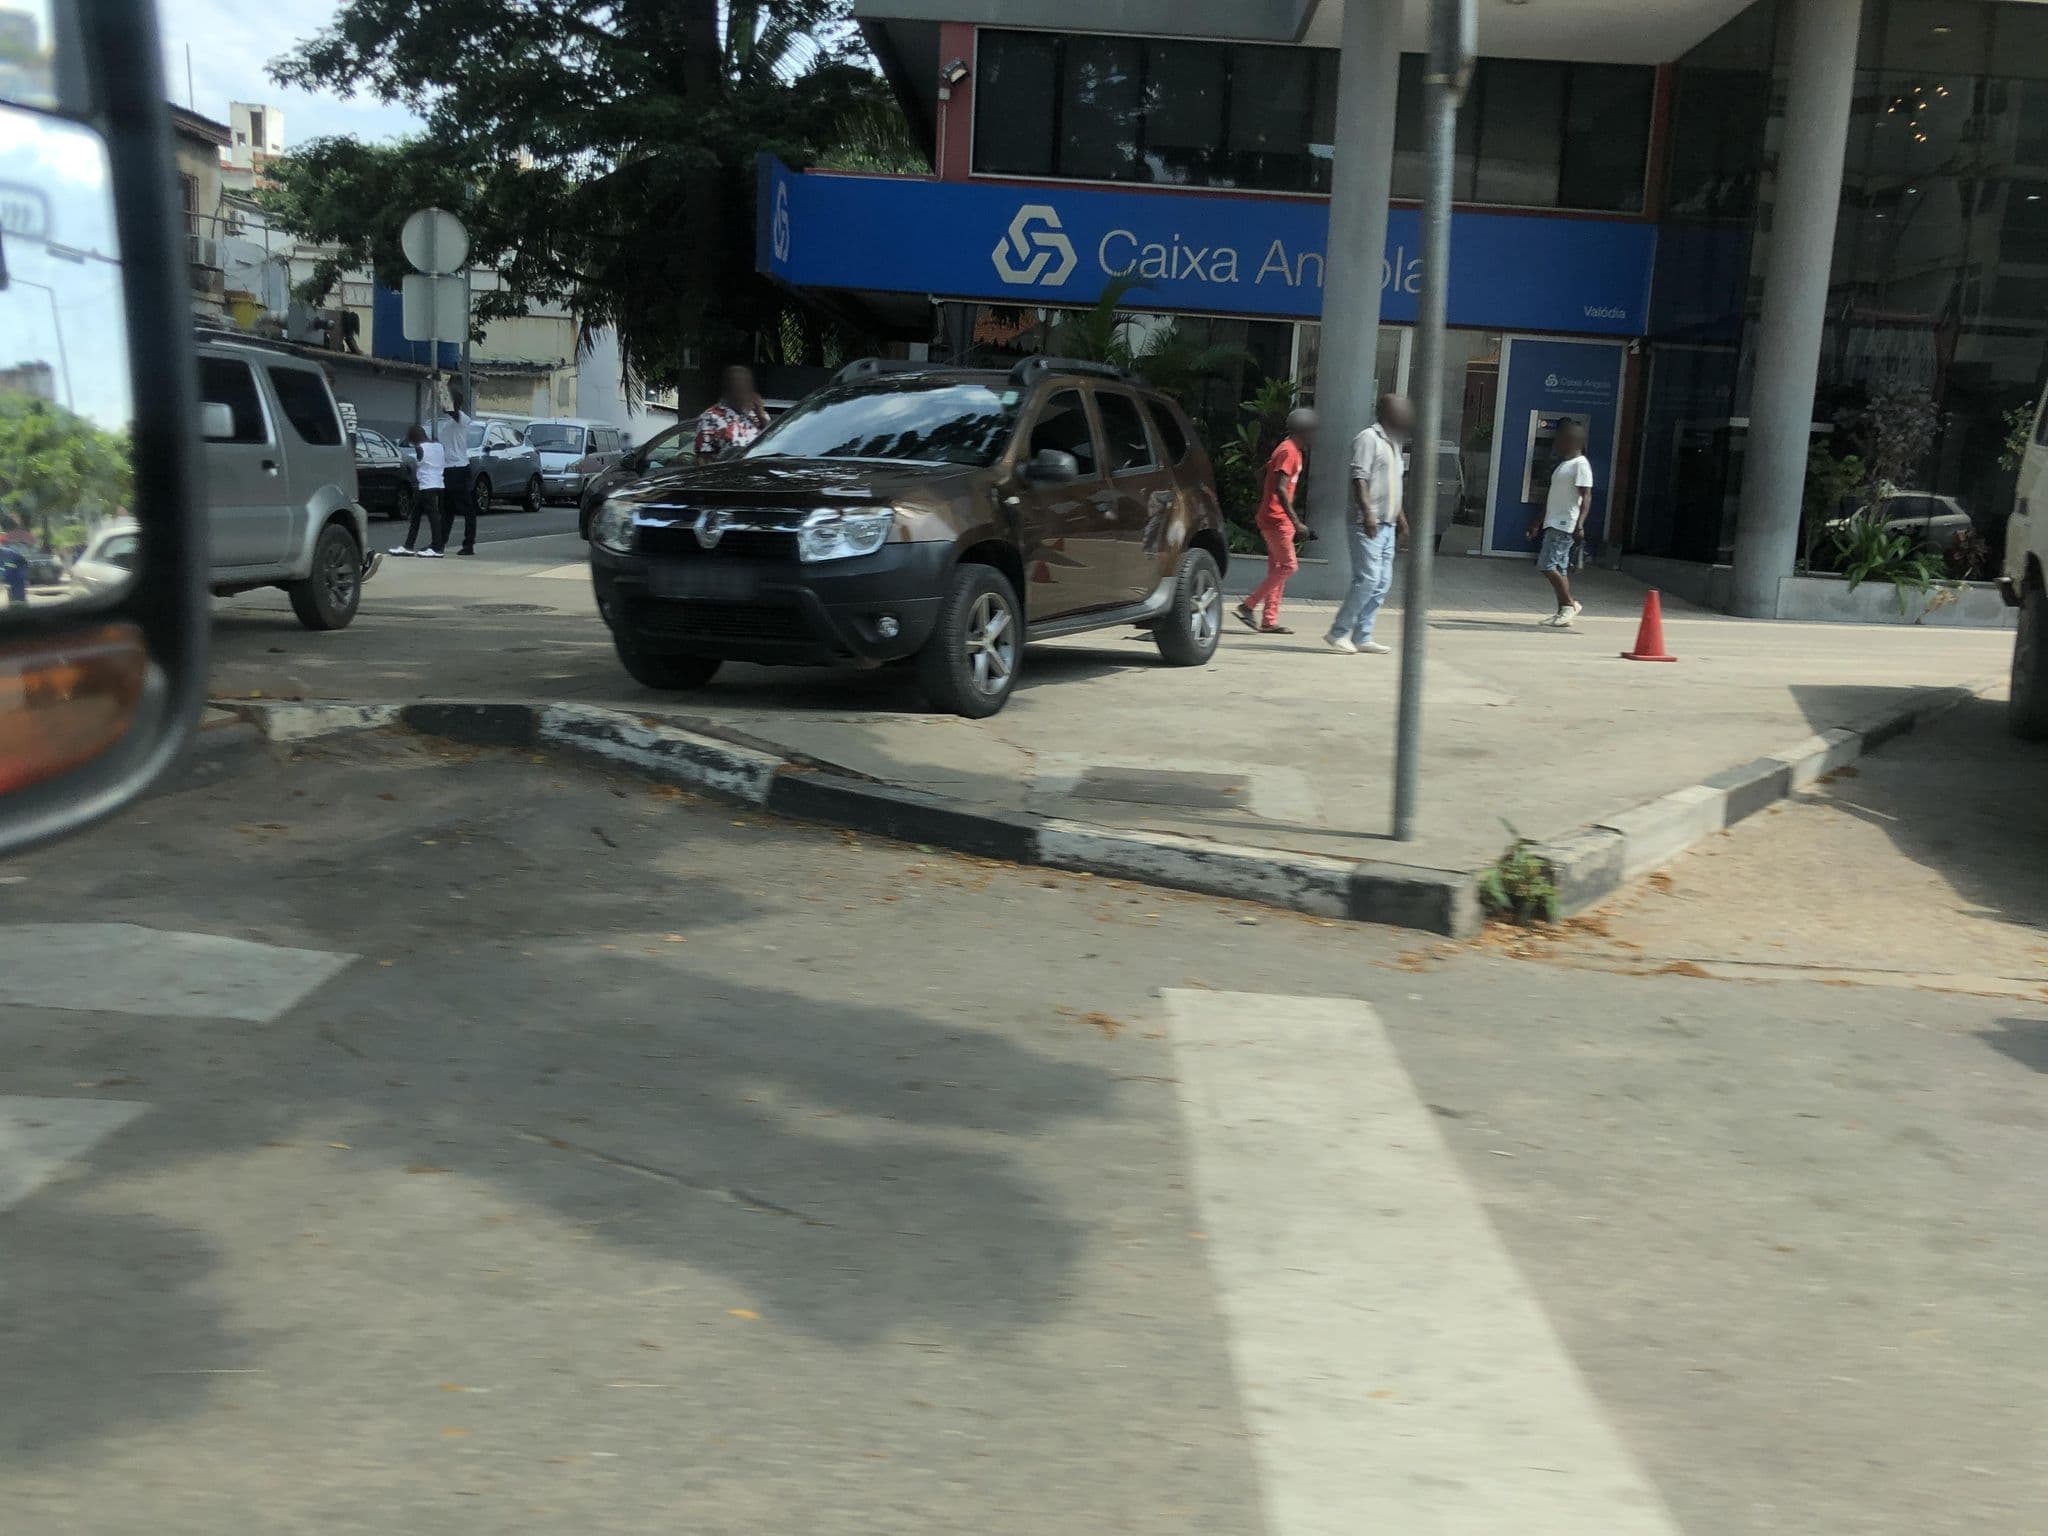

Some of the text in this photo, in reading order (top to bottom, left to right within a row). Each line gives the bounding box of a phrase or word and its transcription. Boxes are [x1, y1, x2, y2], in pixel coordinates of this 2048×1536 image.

[1099, 229, 1425, 294] Caixa Anla
[1583, 304, 1626, 319] Valódia
